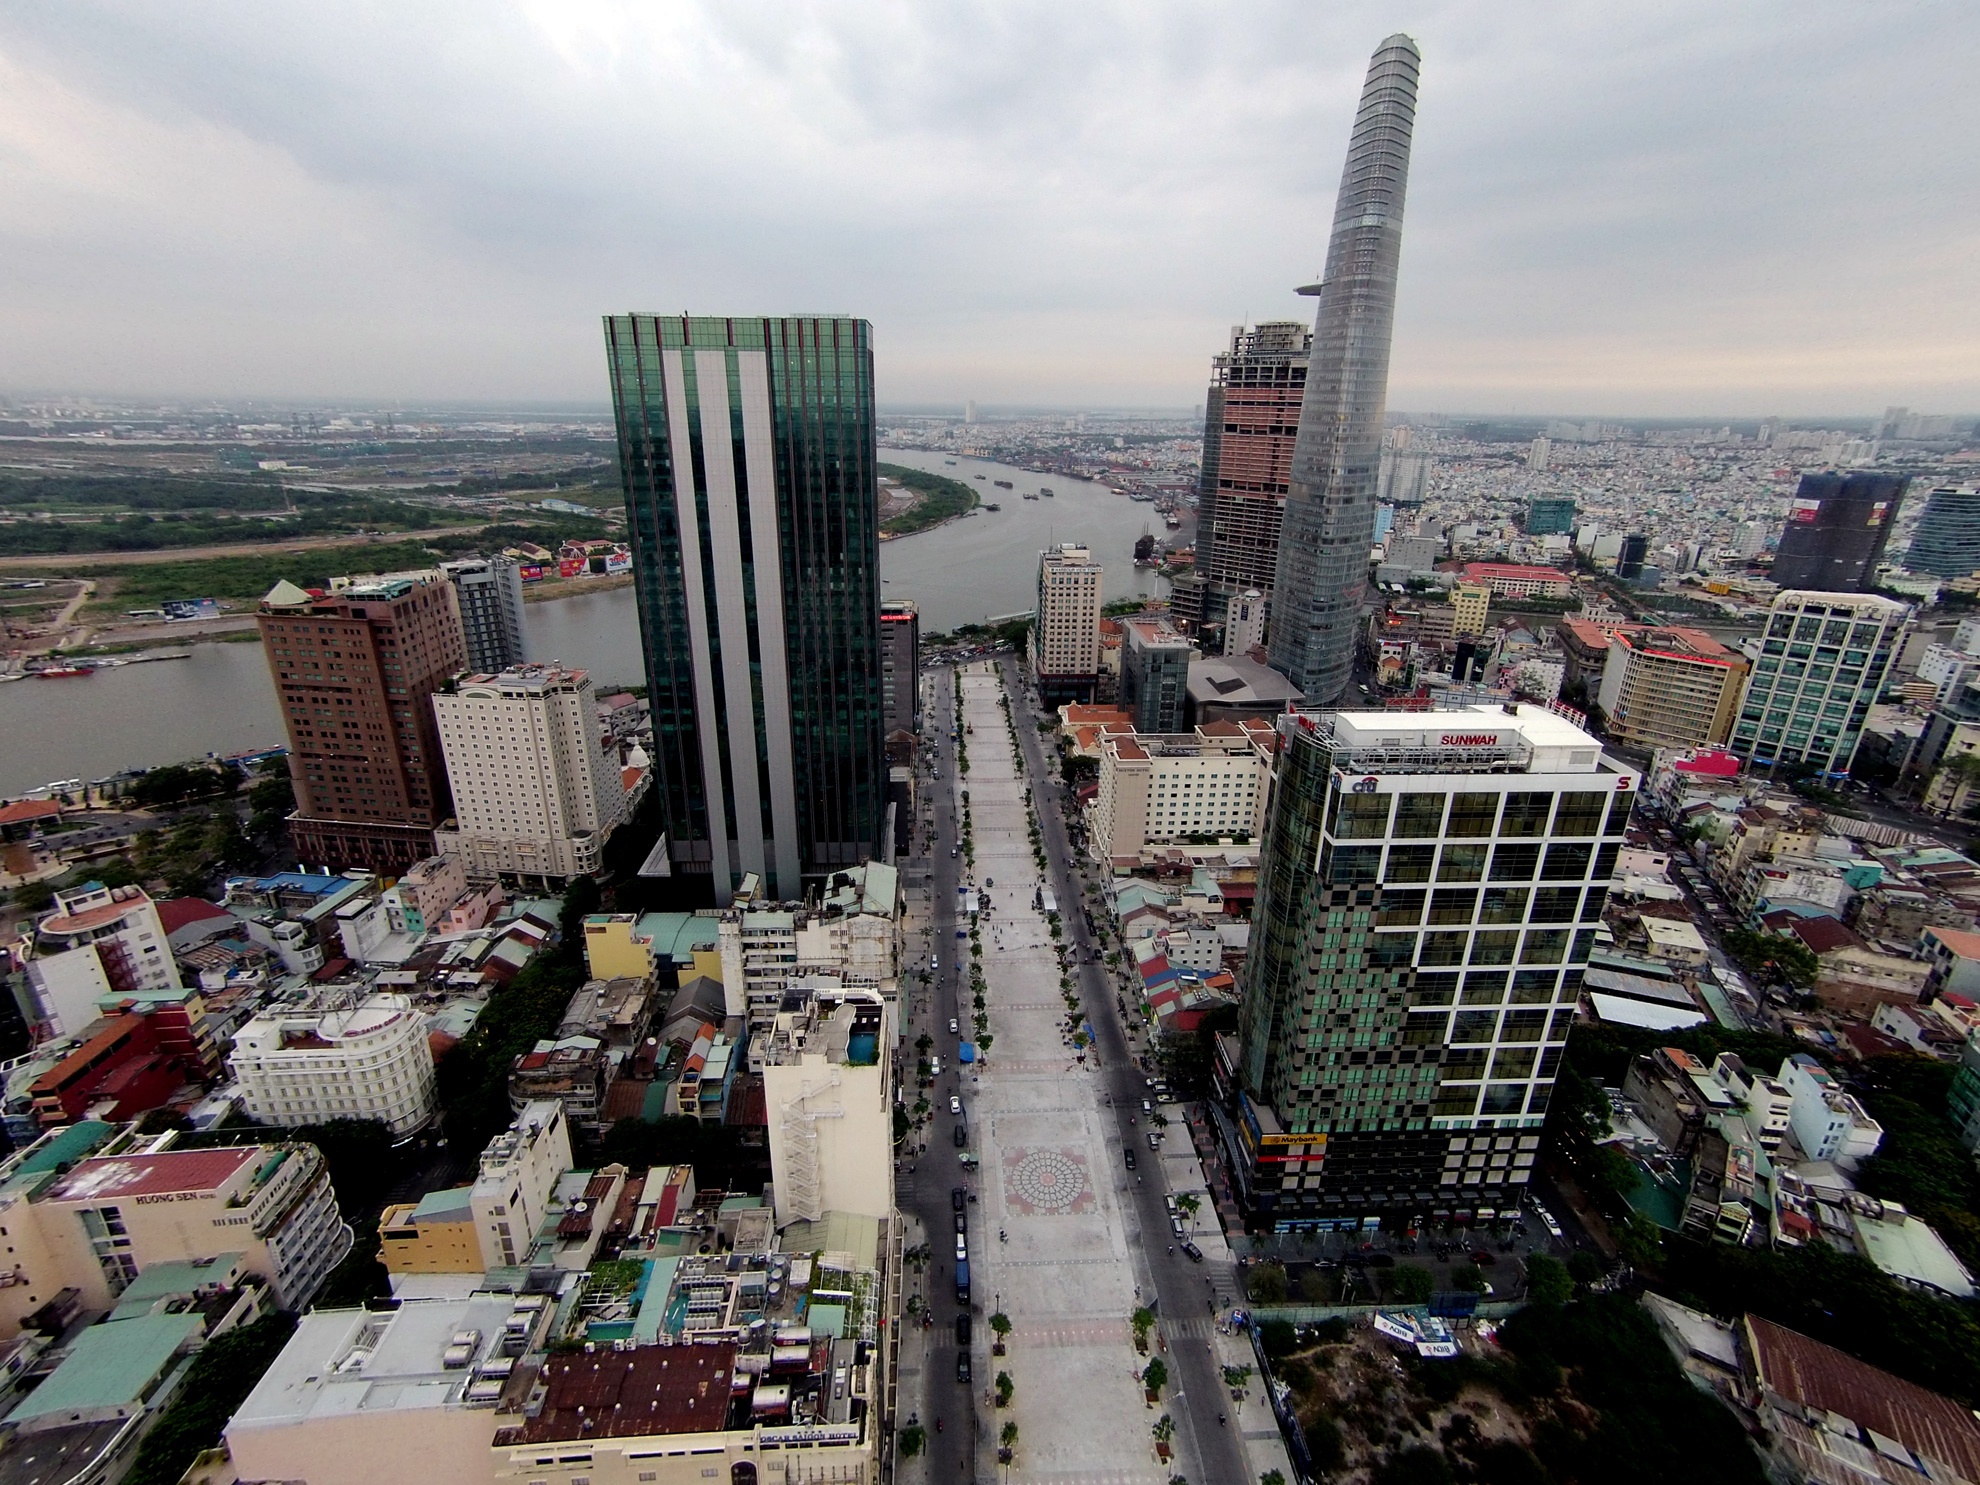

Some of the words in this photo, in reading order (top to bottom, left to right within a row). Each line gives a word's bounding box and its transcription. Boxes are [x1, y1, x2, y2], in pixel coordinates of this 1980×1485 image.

[1806, 600, 1854, 610] Hanwha
[1855, 604, 1879, 613] Life
[1441, 735, 1498, 745] SUNWAH
[1352, 777, 1379, 793] citi
[361, 1024, 383, 1034] SATRA
[136, 1194, 174, 1204] HUONG
[176, 1192, 197, 1201] SEN
[1433, 1345, 1450, 1353] BIDV
[760, 1435, 790, 1443] OSCAR
[792, 1433, 826, 1442] SAIGON
[829, 1432, 858, 1440] HOTEL
